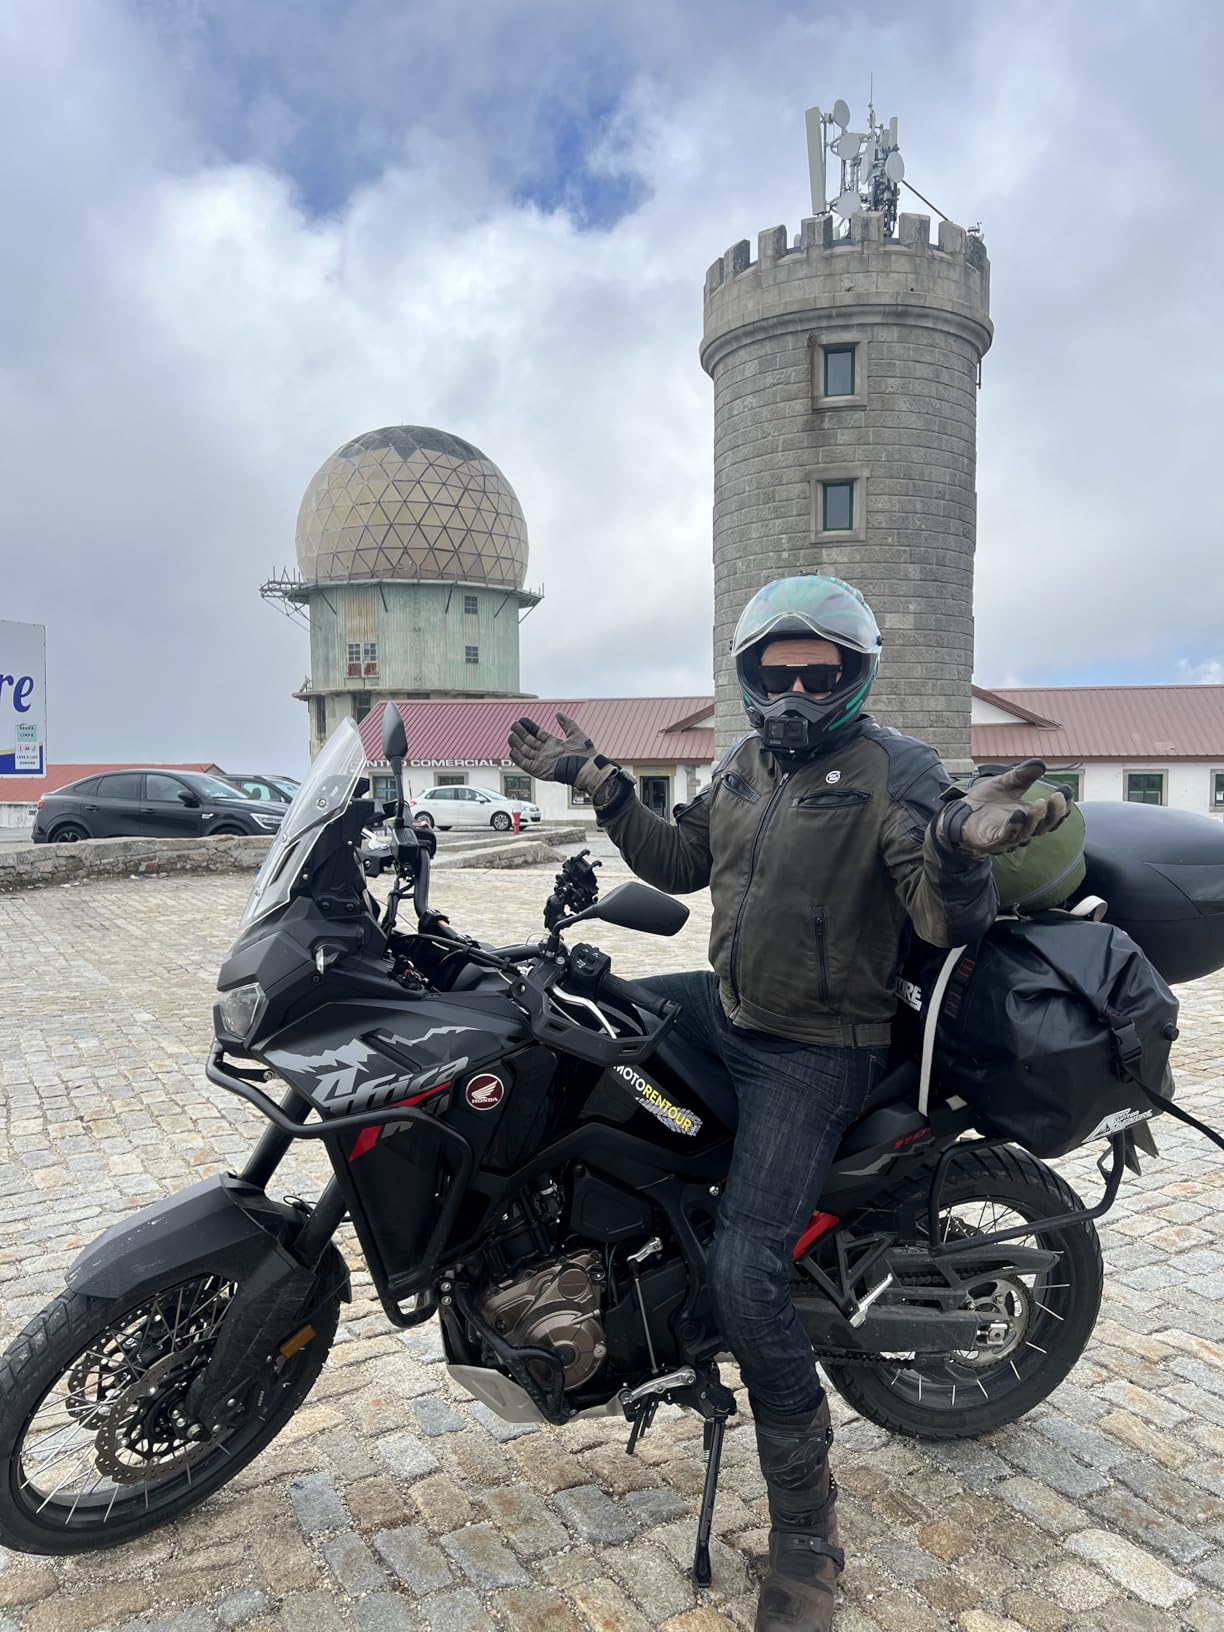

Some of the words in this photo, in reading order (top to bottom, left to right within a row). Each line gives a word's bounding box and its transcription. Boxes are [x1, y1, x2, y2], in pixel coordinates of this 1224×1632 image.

[410, 759, 498, 767] COMERCIAL
[501, 759, 516, 767] D
[471, 1096, 499, 1104] HONDA
